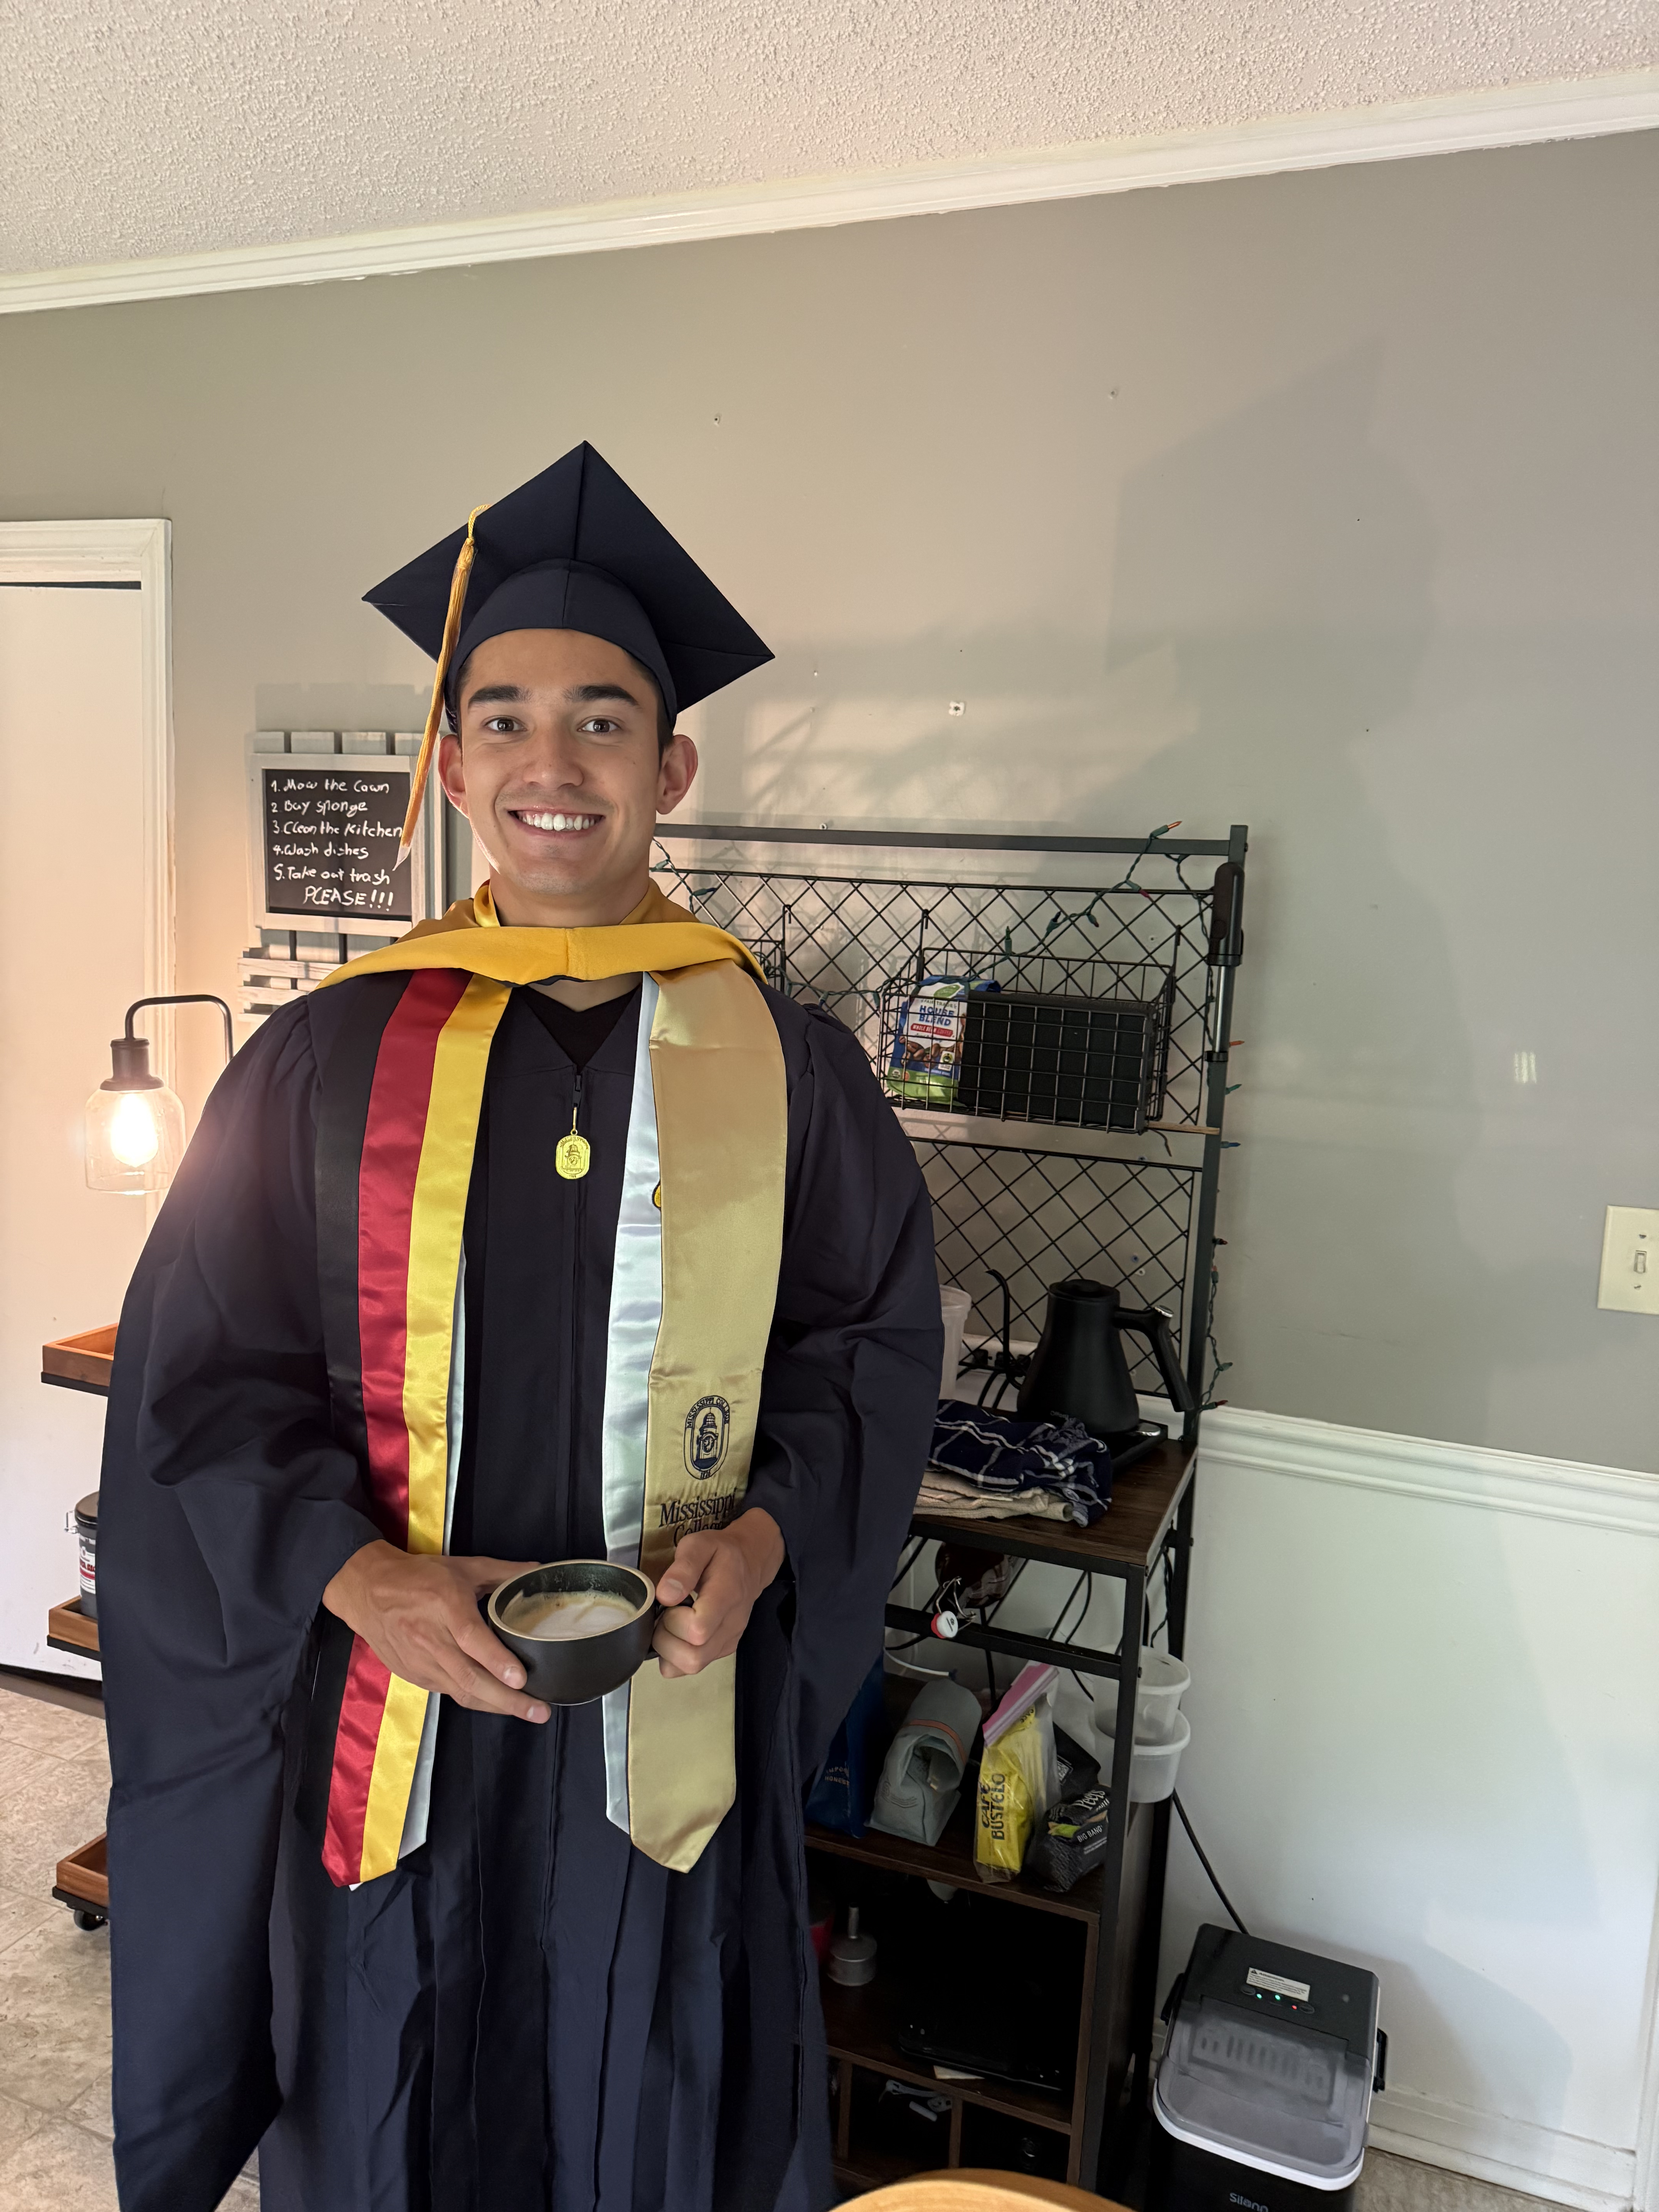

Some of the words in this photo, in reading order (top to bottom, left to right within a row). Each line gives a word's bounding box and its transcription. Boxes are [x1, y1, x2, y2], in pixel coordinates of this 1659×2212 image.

[324, 778, 348, 791] the
[320, 820, 340, 835] the
[284, 842, 319, 857] Wash
[324, 841, 369, 860] dishes
[287, 866, 317, 881] Take
[320, 868, 345, 881] out
[349, 867, 390, 886] trash
[919, 1005, 955, 1017] HOUSE
[918, 1014, 951, 1026] BLEND
[658, 1486, 737, 1528] Mississippi
[990, 1773, 1006, 1840] BUSTELO
[1077, 1833, 1088, 1843] BIG
